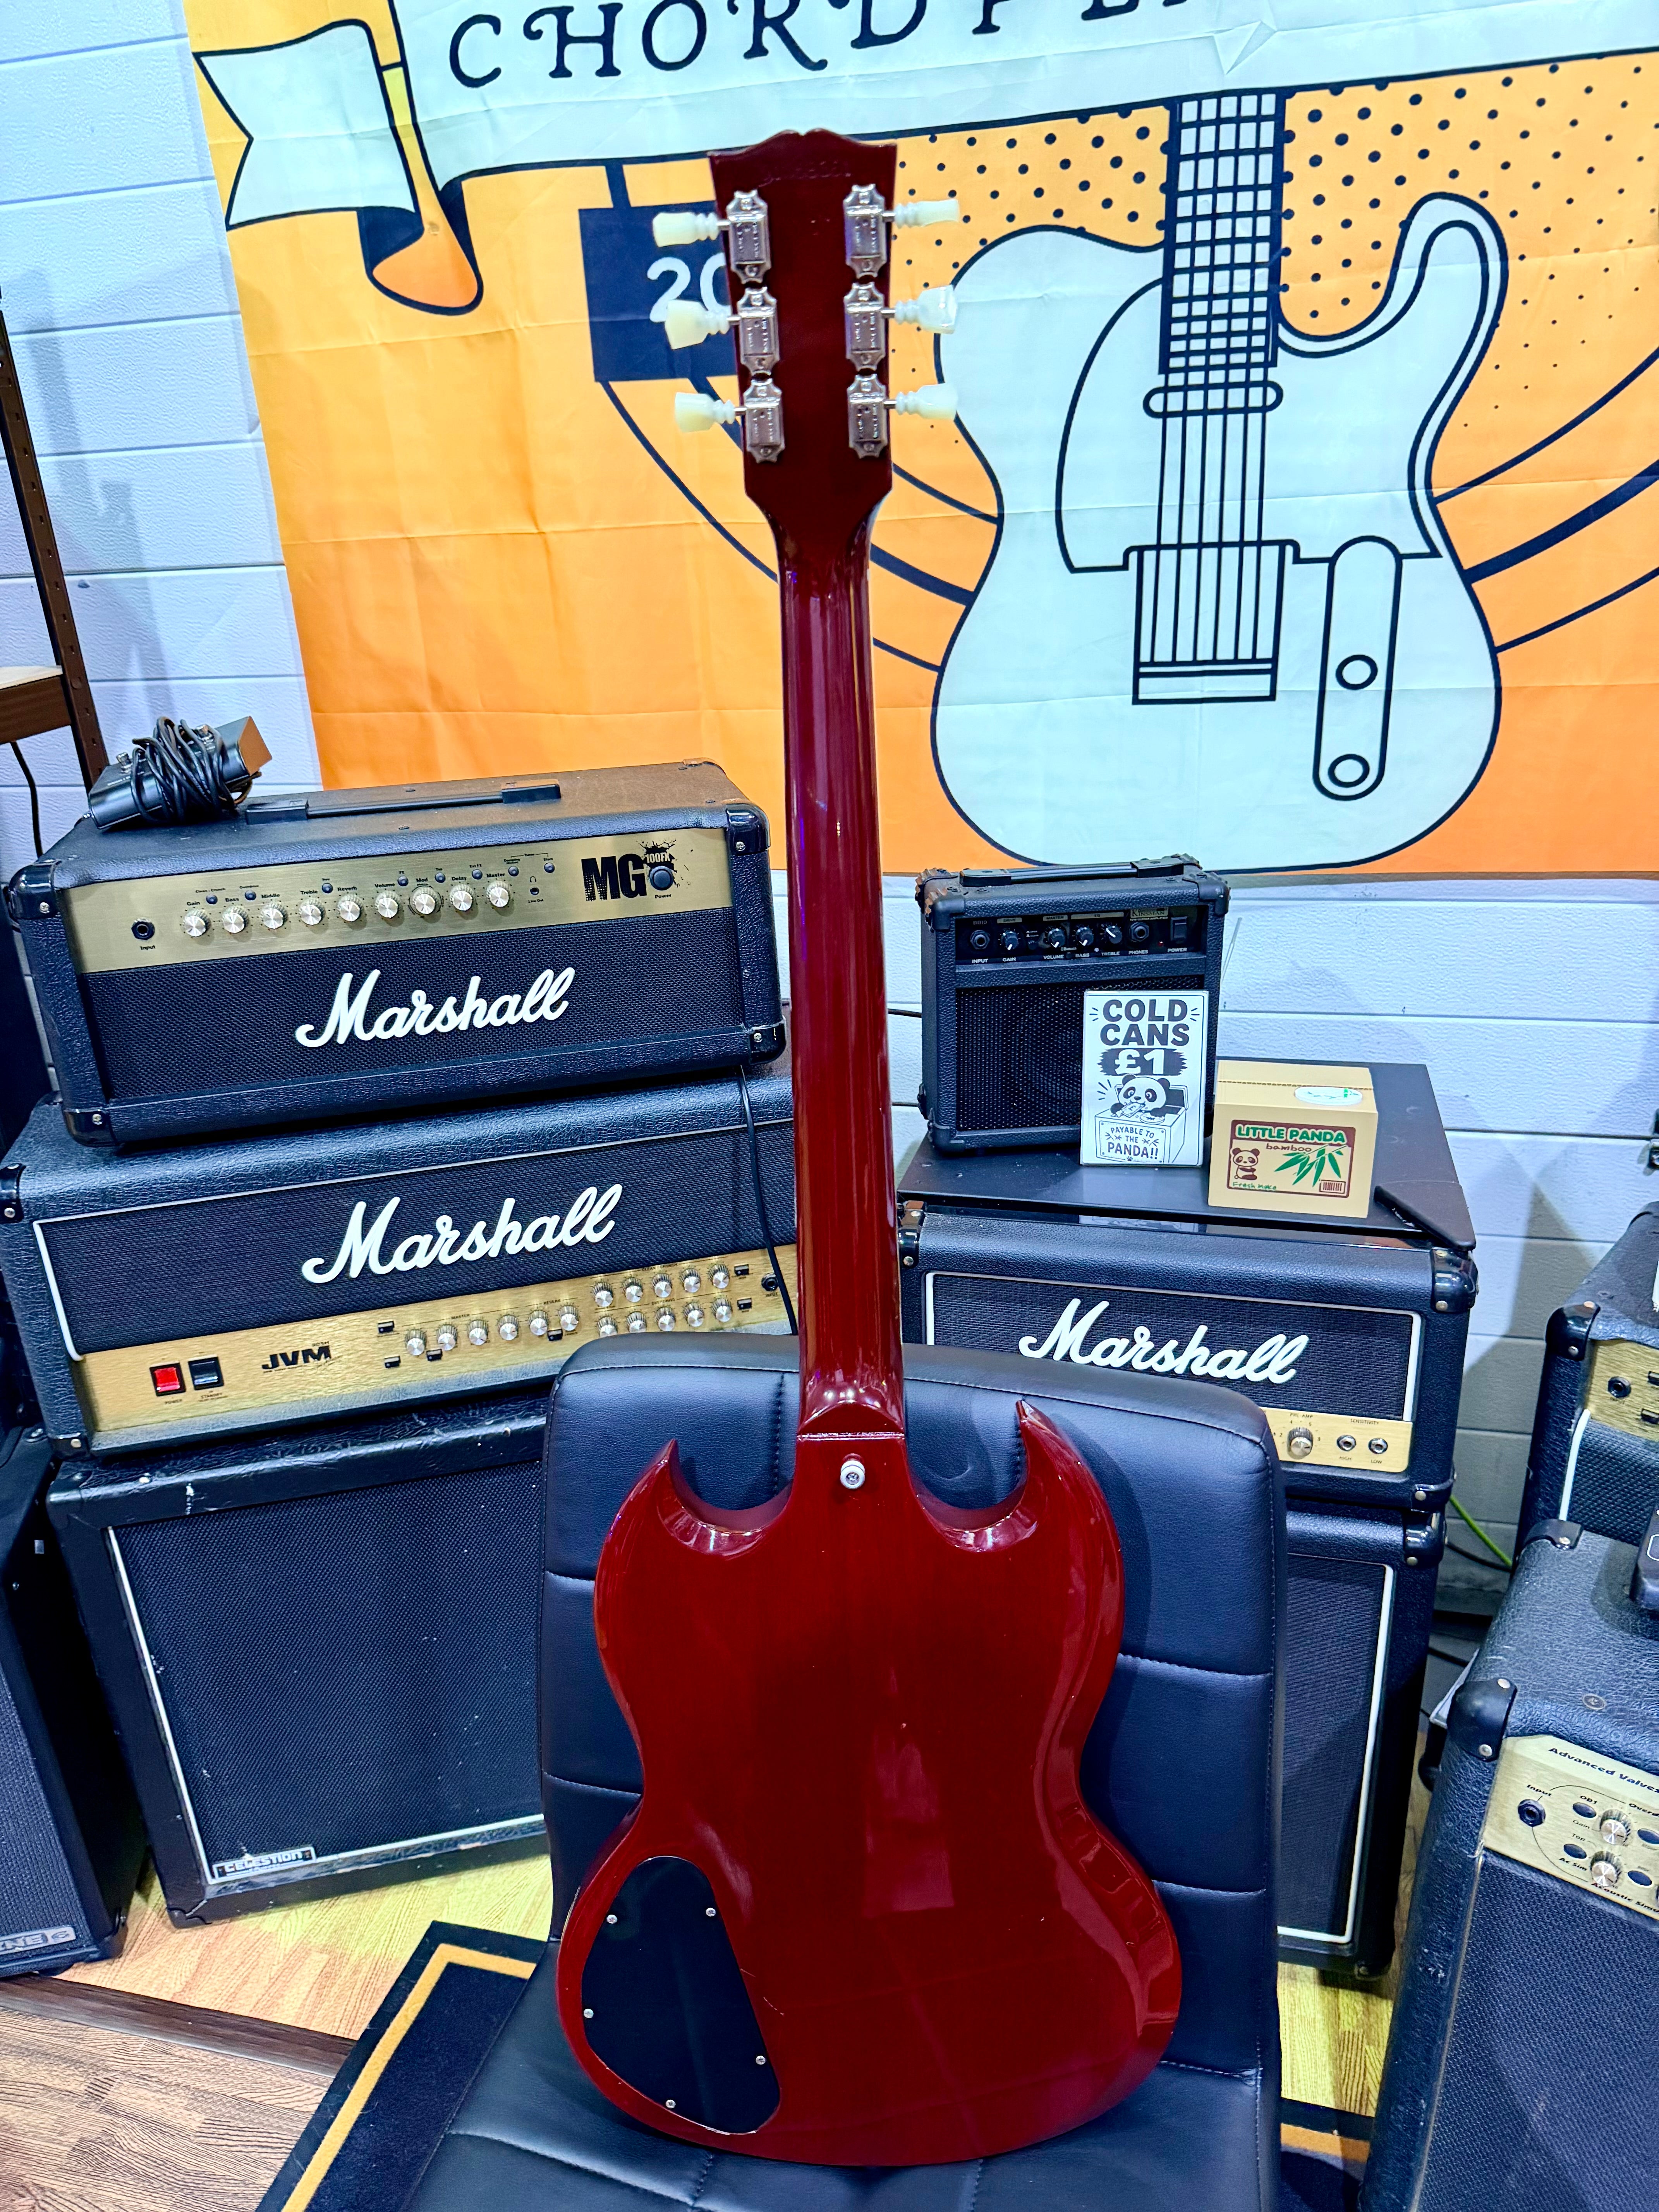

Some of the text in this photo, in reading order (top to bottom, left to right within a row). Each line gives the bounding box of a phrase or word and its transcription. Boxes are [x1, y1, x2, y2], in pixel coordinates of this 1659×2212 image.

[449, 0, 927, 88] CHORD
[646, 852, 670, 863] 100FX
[581, 854, 647, 901] MG
[295, 967, 575, 1048] Marshall
[1103, 999, 1188, 1022] COLD
[1100, 1024, 1190, 1046] CANS
[1115, 1049, 1164, 1075] £1
[1111, 1127, 1154, 1138] PAYABLE TO
[1237, 1126, 1345, 1143] LITTLE PANDA
[1108, 1142, 1158, 1159] PANDA!!
[1266, 1143, 1312, 1152] bamboo
[302, 1184, 622, 1283] Marshall
[1018, 1298, 1309, 1384] Marshall
[262, 1345, 331, 1369] JVM
[1548, 1748, 1616, 1775] Advanced
[1527, 1784, 1552, 1797] Input
[1580, 1795, 1598, 1805] OD1
[1573, 1820, 1590, 1829] Gain
[1571, 1833, 1585, 1841] Top
[1572, 1863, 1587, 1871] Sim
[1591, 1883, 1633, 1902] Acoustic
